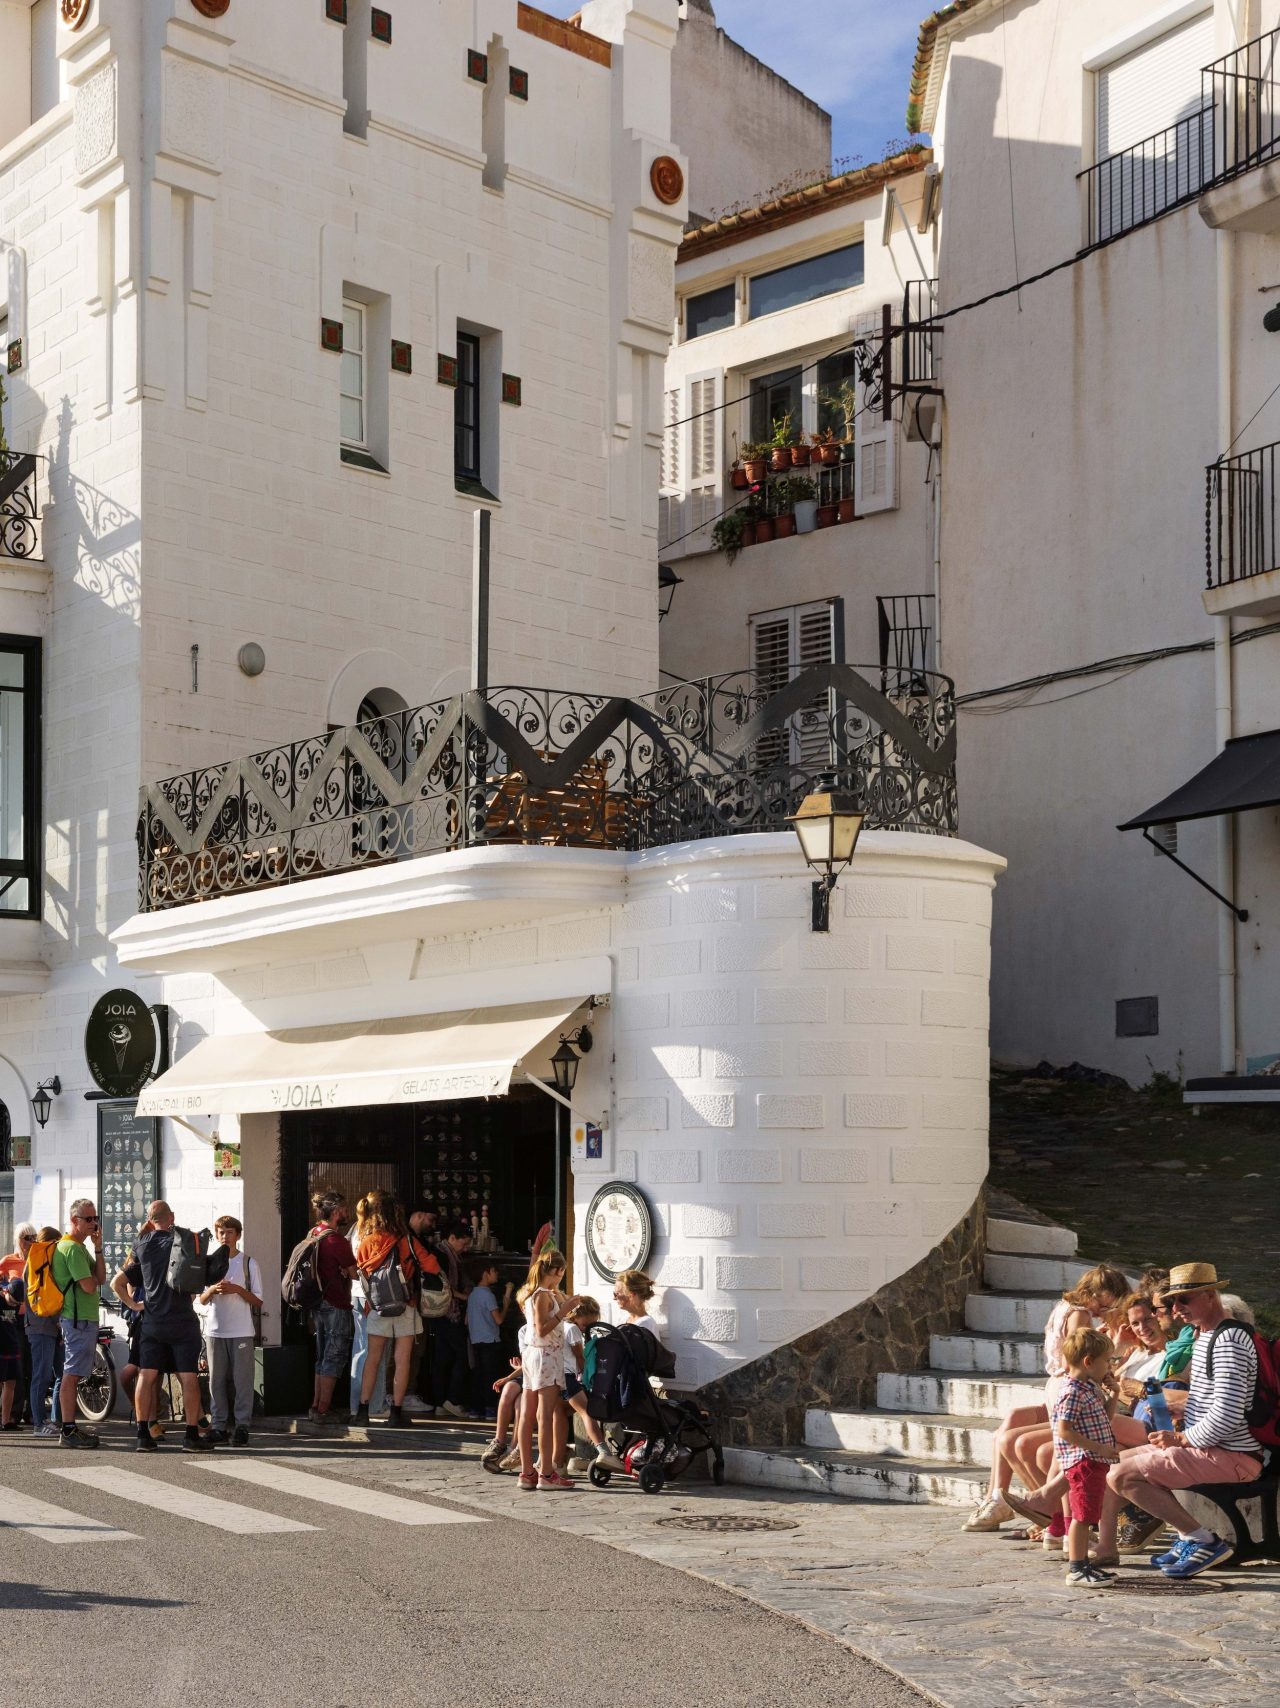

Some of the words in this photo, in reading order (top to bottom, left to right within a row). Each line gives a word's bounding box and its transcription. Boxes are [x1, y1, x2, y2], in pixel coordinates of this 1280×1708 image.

[104, 1004, 137, 1016] JOIA
[91, 1061, 105, 1083] MADE
[108, 1085, 118, 1095] IN
[282, 1083, 323, 1109] JOIA
